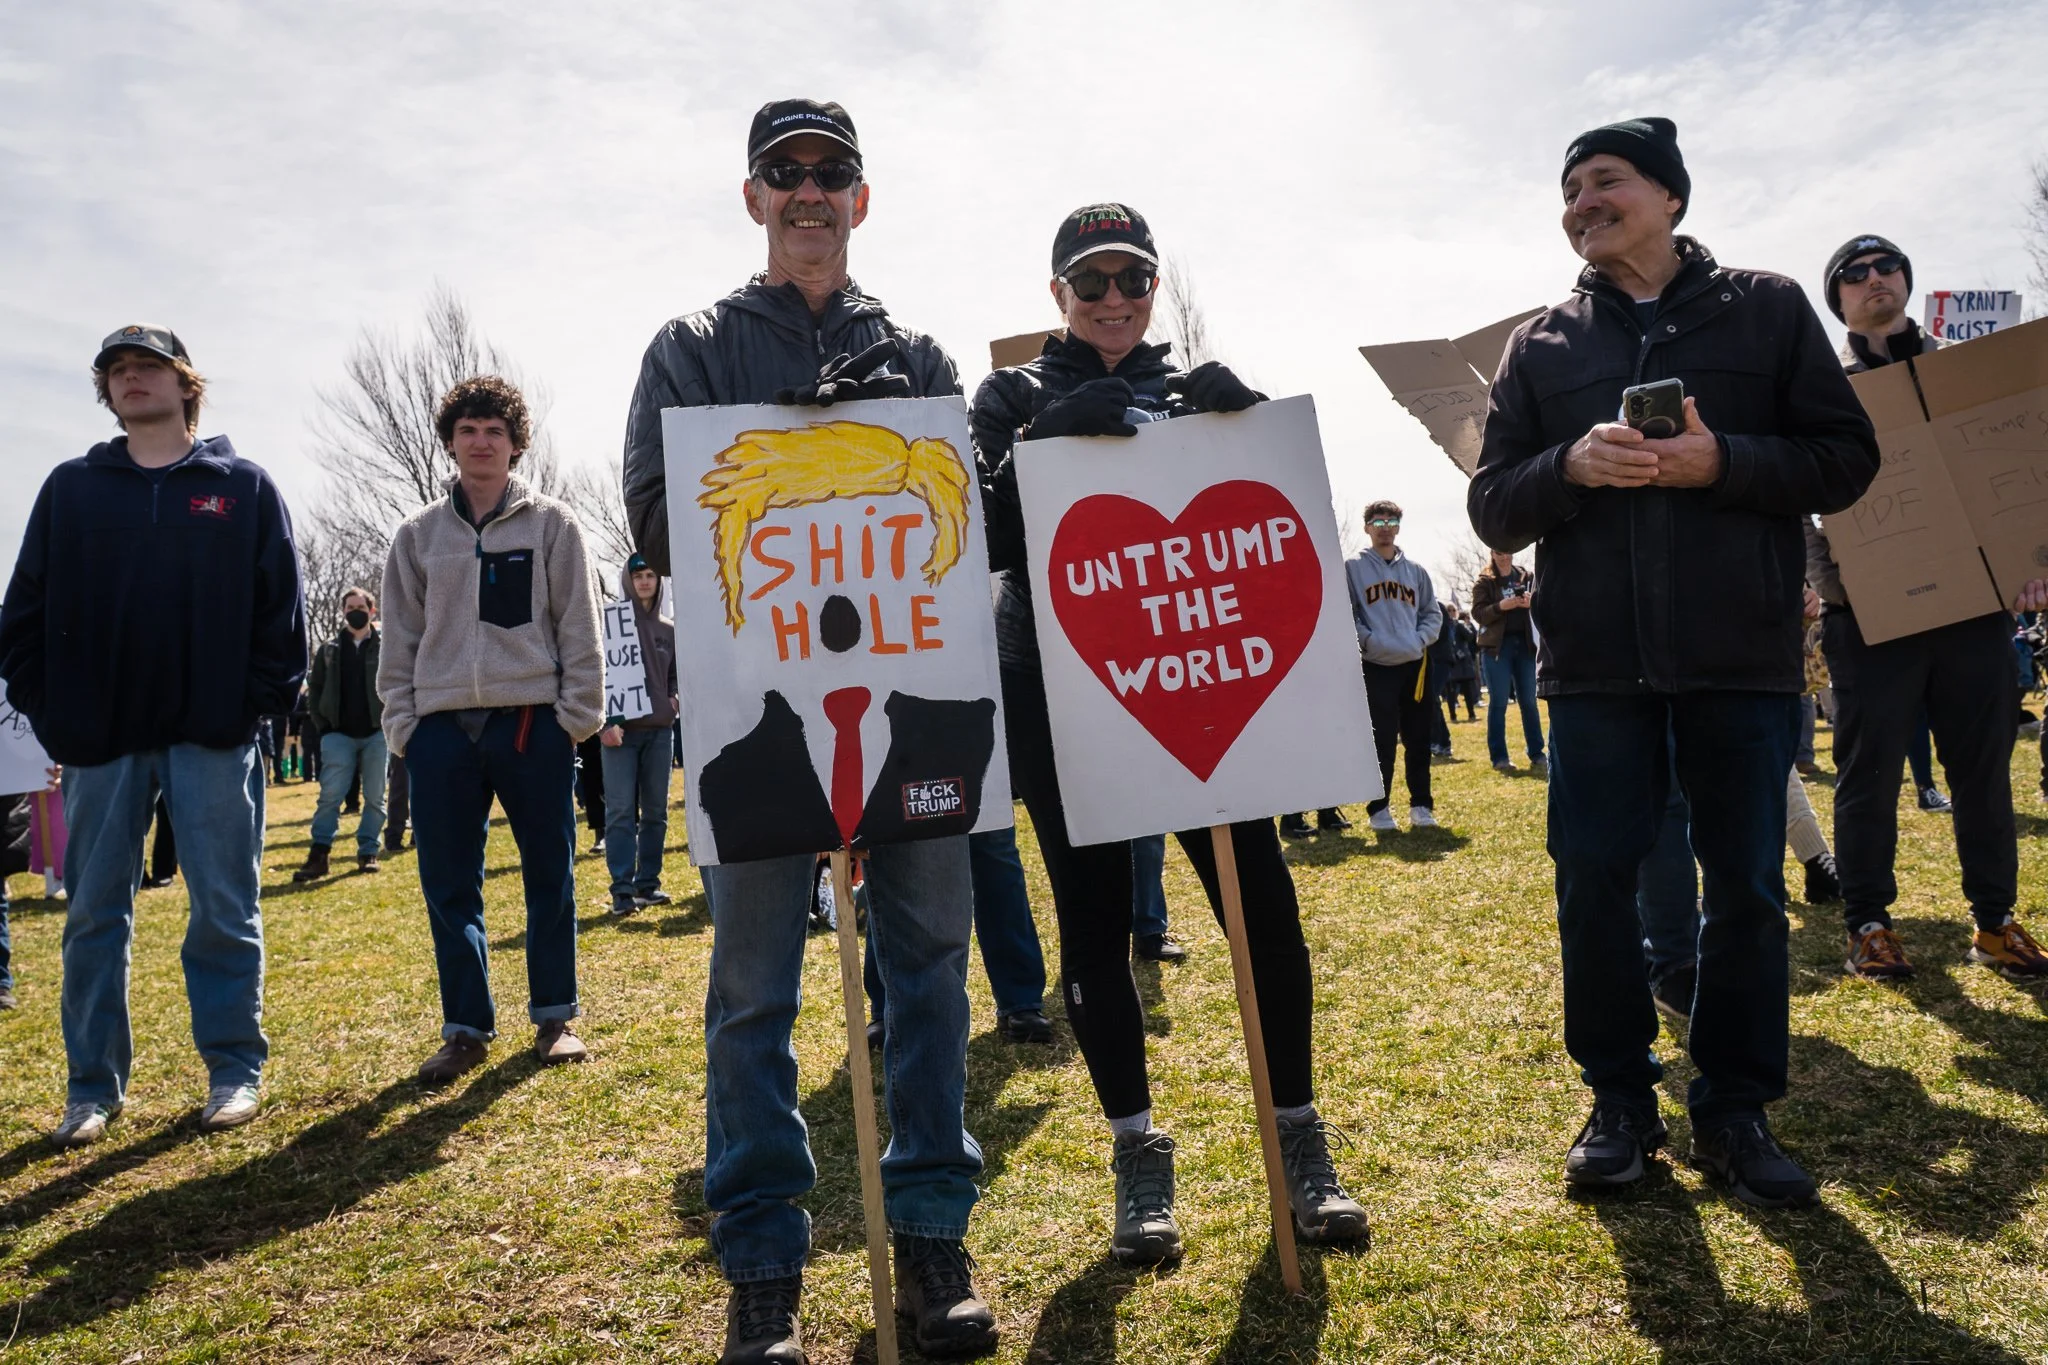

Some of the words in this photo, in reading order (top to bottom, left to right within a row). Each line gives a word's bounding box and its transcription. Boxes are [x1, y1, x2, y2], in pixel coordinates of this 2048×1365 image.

[771, 113, 805, 126] IMAGINE
[805, 113, 833, 124] PEACE
[1078, 219, 1132, 236] POWER
[1932, 290, 2013, 316] TYRANT
[1851, 487, 1923, 537] PDF
[748, 505, 924, 601] SHIT
[1066, 516, 1298, 597] UNTRUMP
[1140, 583, 1243, 637] THE
[1364, 579, 1416, 608] UWM
[770, 592, 945, 662] HOLE
[1105, 635, 1275, 698] WORLD
[907, 796, 961, 815] TRUMP
